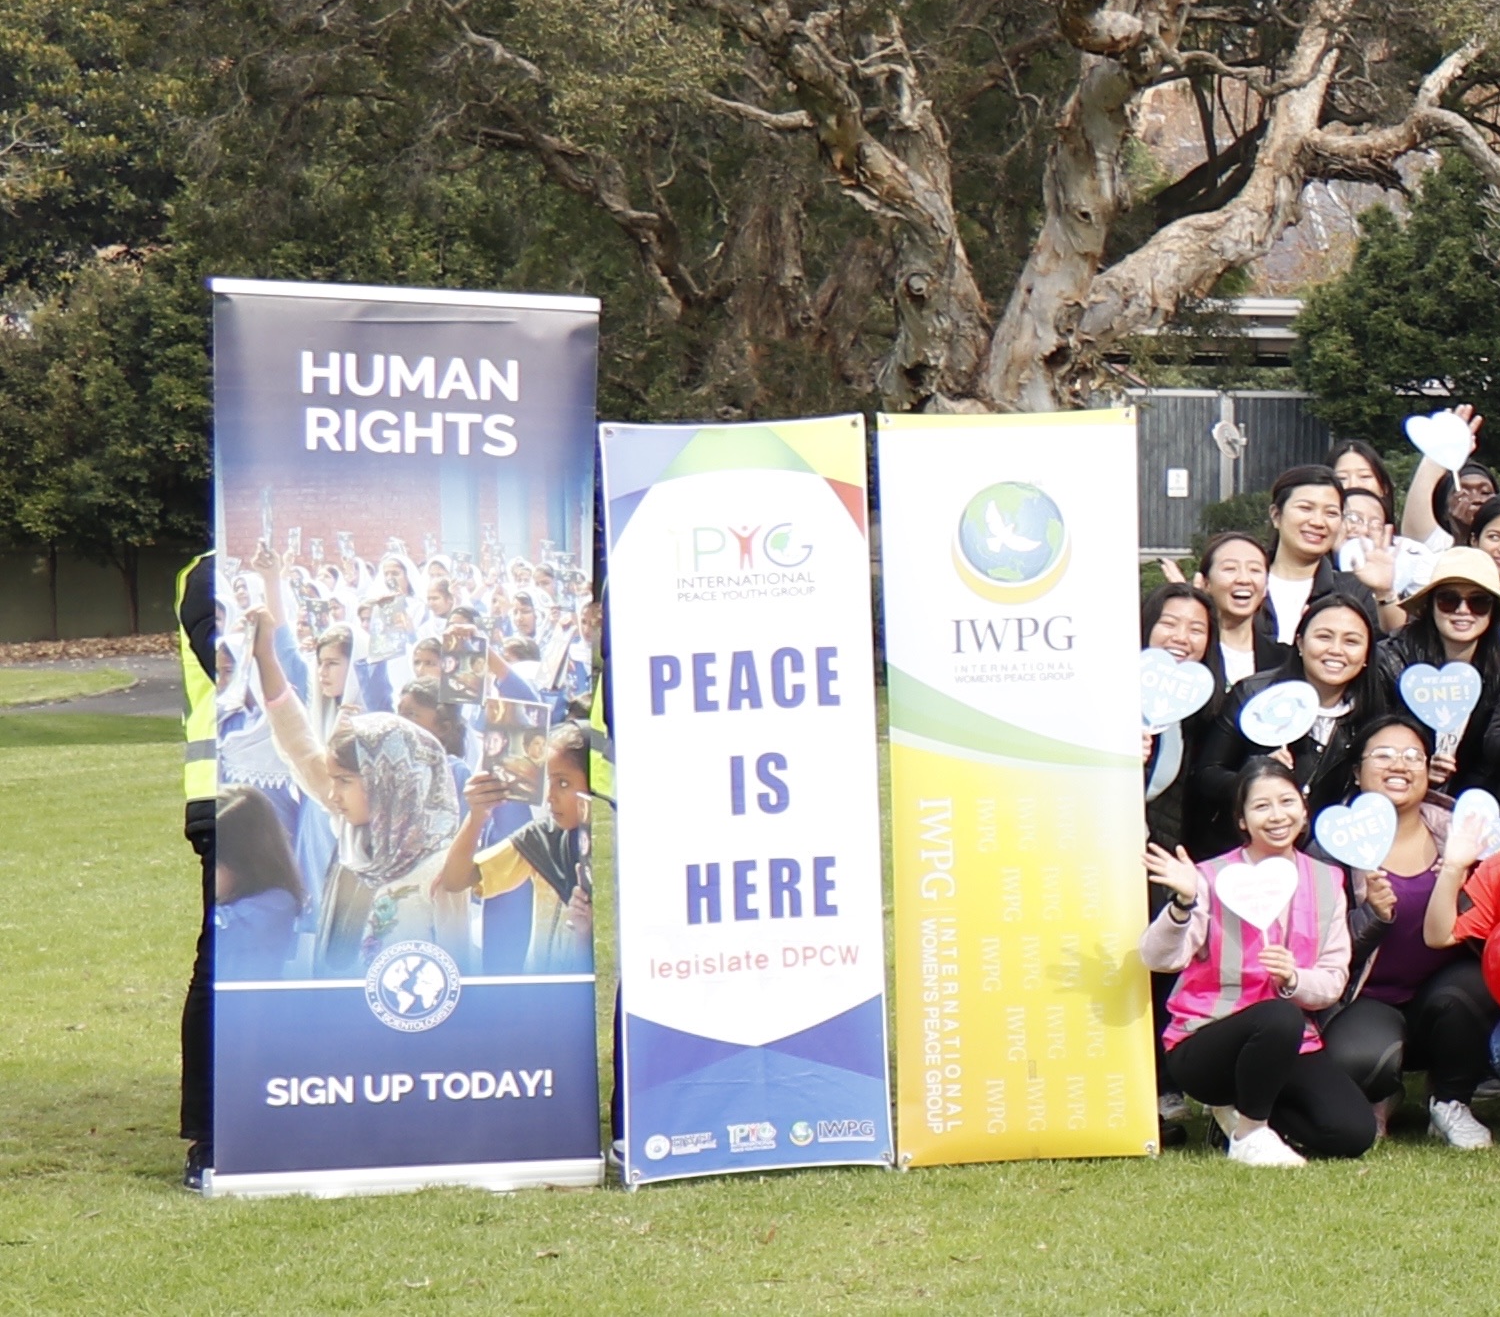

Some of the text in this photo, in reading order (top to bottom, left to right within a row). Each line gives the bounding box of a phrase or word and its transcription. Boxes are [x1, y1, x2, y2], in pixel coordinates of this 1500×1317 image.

[300, 350, 519, 402] HUMAN
[305, 407, 518, 457] RIGHTS
[677, 572, 815, 589] INTERNATIONAL
[677, 585, 815, 602] PEACE YOUTH GROUP
[951, 615, 1077, 655] IWPG
[649, 647, 841, 716] PEACE
[955, 662, 1074, 674] INTERNATIONAL
[955, 671, 1075, 684] WOMEN'S PEACE GROUP
[1141, 670, 1199, 703] ONE!
[1414, 685, 1470, 703] ONE!
[730, 752, 790, 816] IS
[686, 856, 839, 925] HERE
[650, 945, 860, 979] legislate DPCW
[918, 797, 963, 1132] IWPG INTERNATIONAL
[921, 918, 944, 1134] WOMEN'S PEACE GROUP
[266, 1069, 554, 1107] SIGN UP TODAY!
[986, 1079, 1006, 1135] IWPG
[818, 1121, 875, 1137] IWPG
